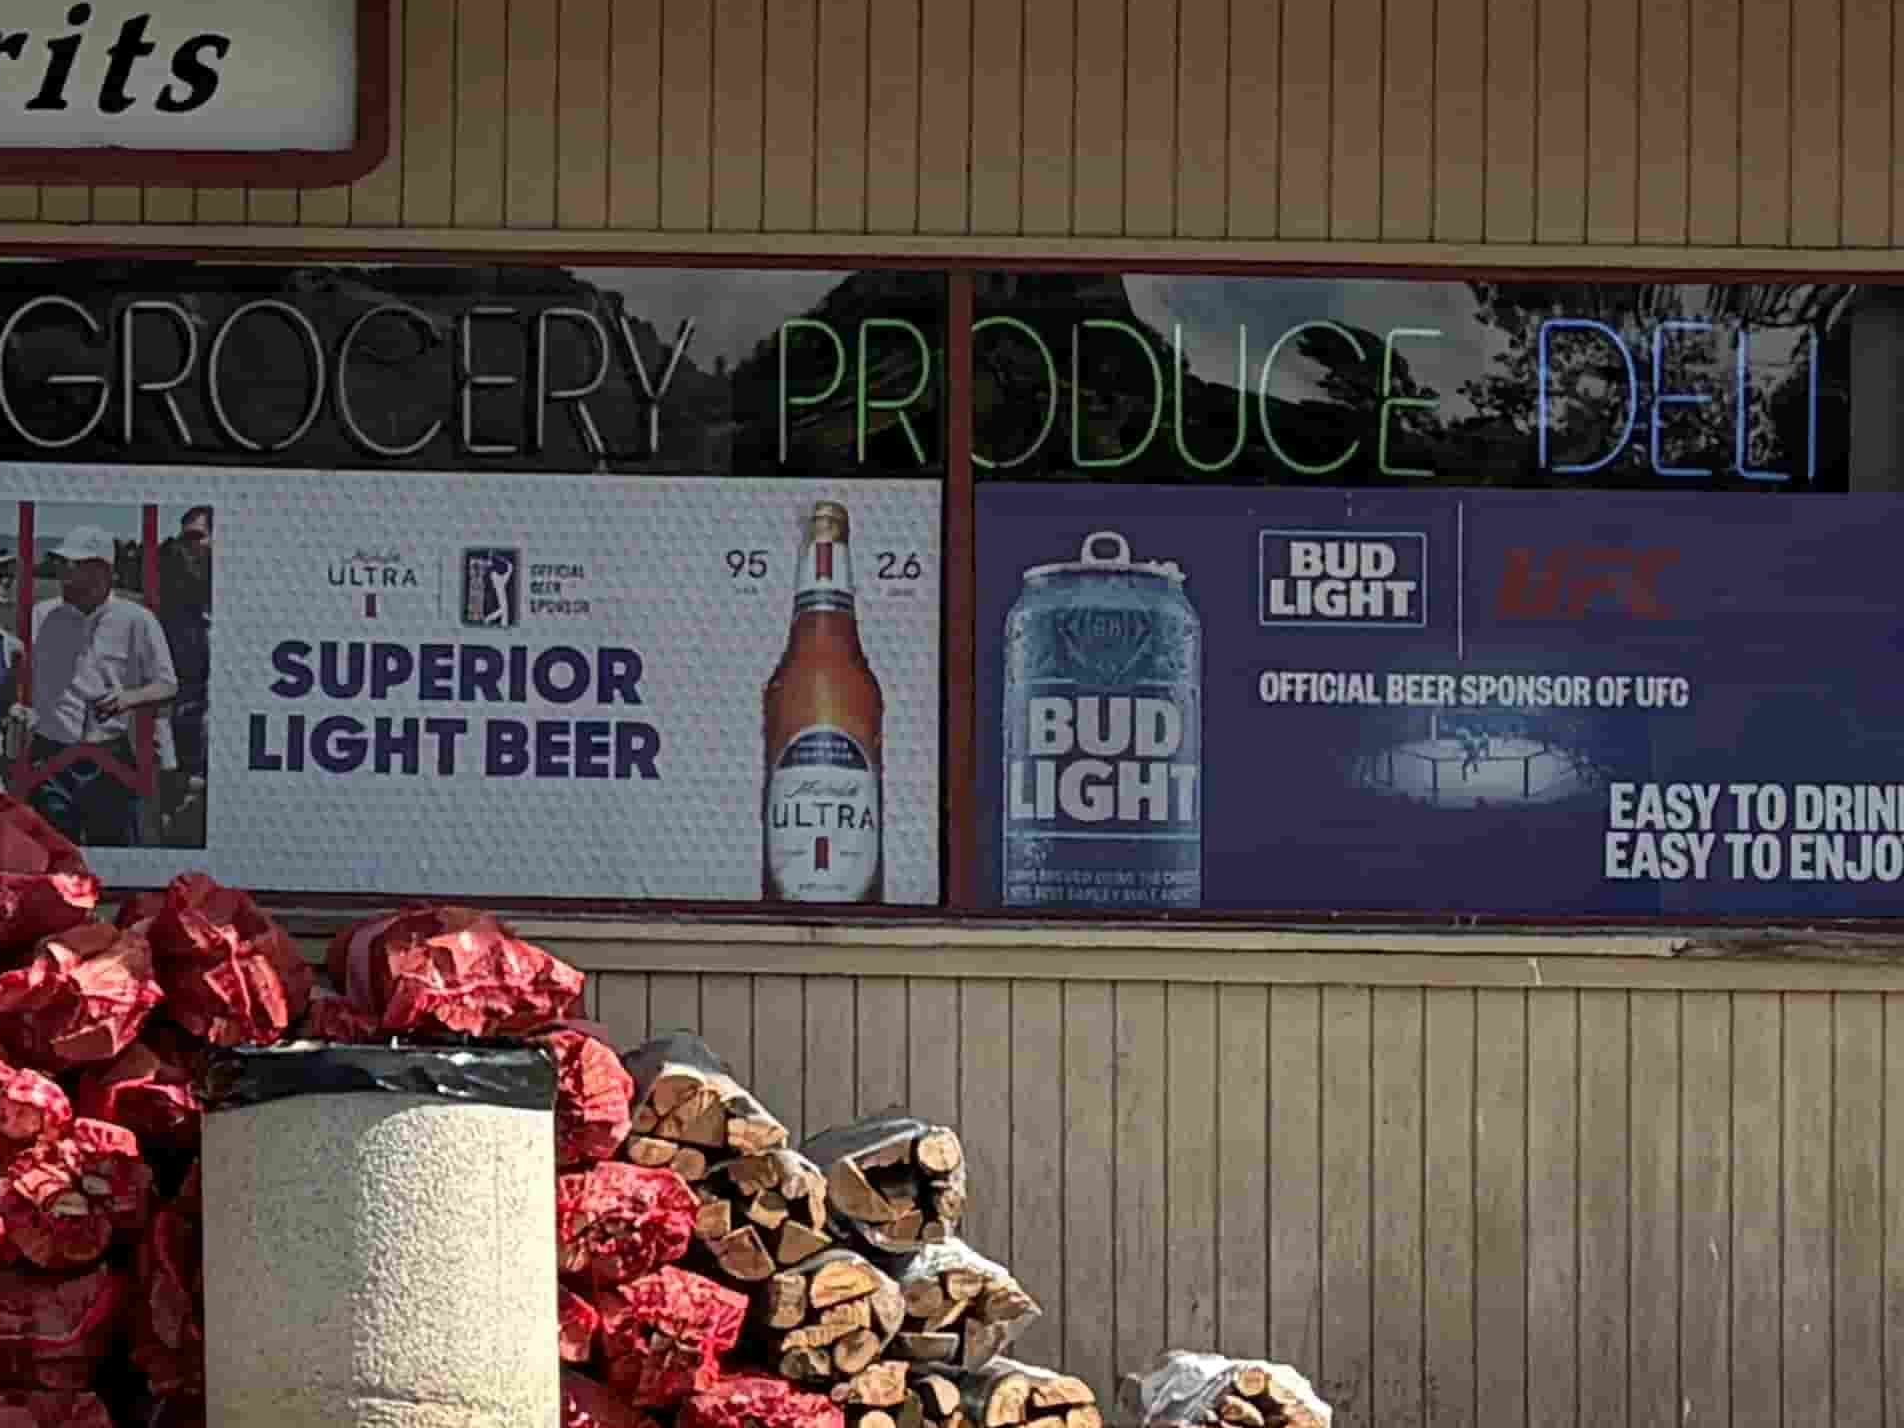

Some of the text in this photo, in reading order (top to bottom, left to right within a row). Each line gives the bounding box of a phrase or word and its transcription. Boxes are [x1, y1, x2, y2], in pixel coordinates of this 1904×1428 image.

[775, 314, 1444, 478] PRODUCE
[1536, 316, 1820, 485] DELI
[327, 566, 419, 587] ULTRA
[725, 549, 769, 580] 95
[1288, 541, 1397, 579] BUD
[1496, 547, 1682, 621] UFC
[1268, 577, 1418, 618] LIGHT
[269, 639, 644, 705] SUPERIOR
[1258, 670, 1690, 708] OFFICIAL BEER SPONSOR OF UFC
[248, 713, 662, 780] LIGHT BEER
[1026, 695, 1185, 758] BUD
[772, 801, 876, 830] ULTRA
[1007, 757, 1197, 824] LIGHT
[1609, 782, 1904, 832] EASY TO DRIN
[1604, 831, 1904, 882] EASY TO ENJO
